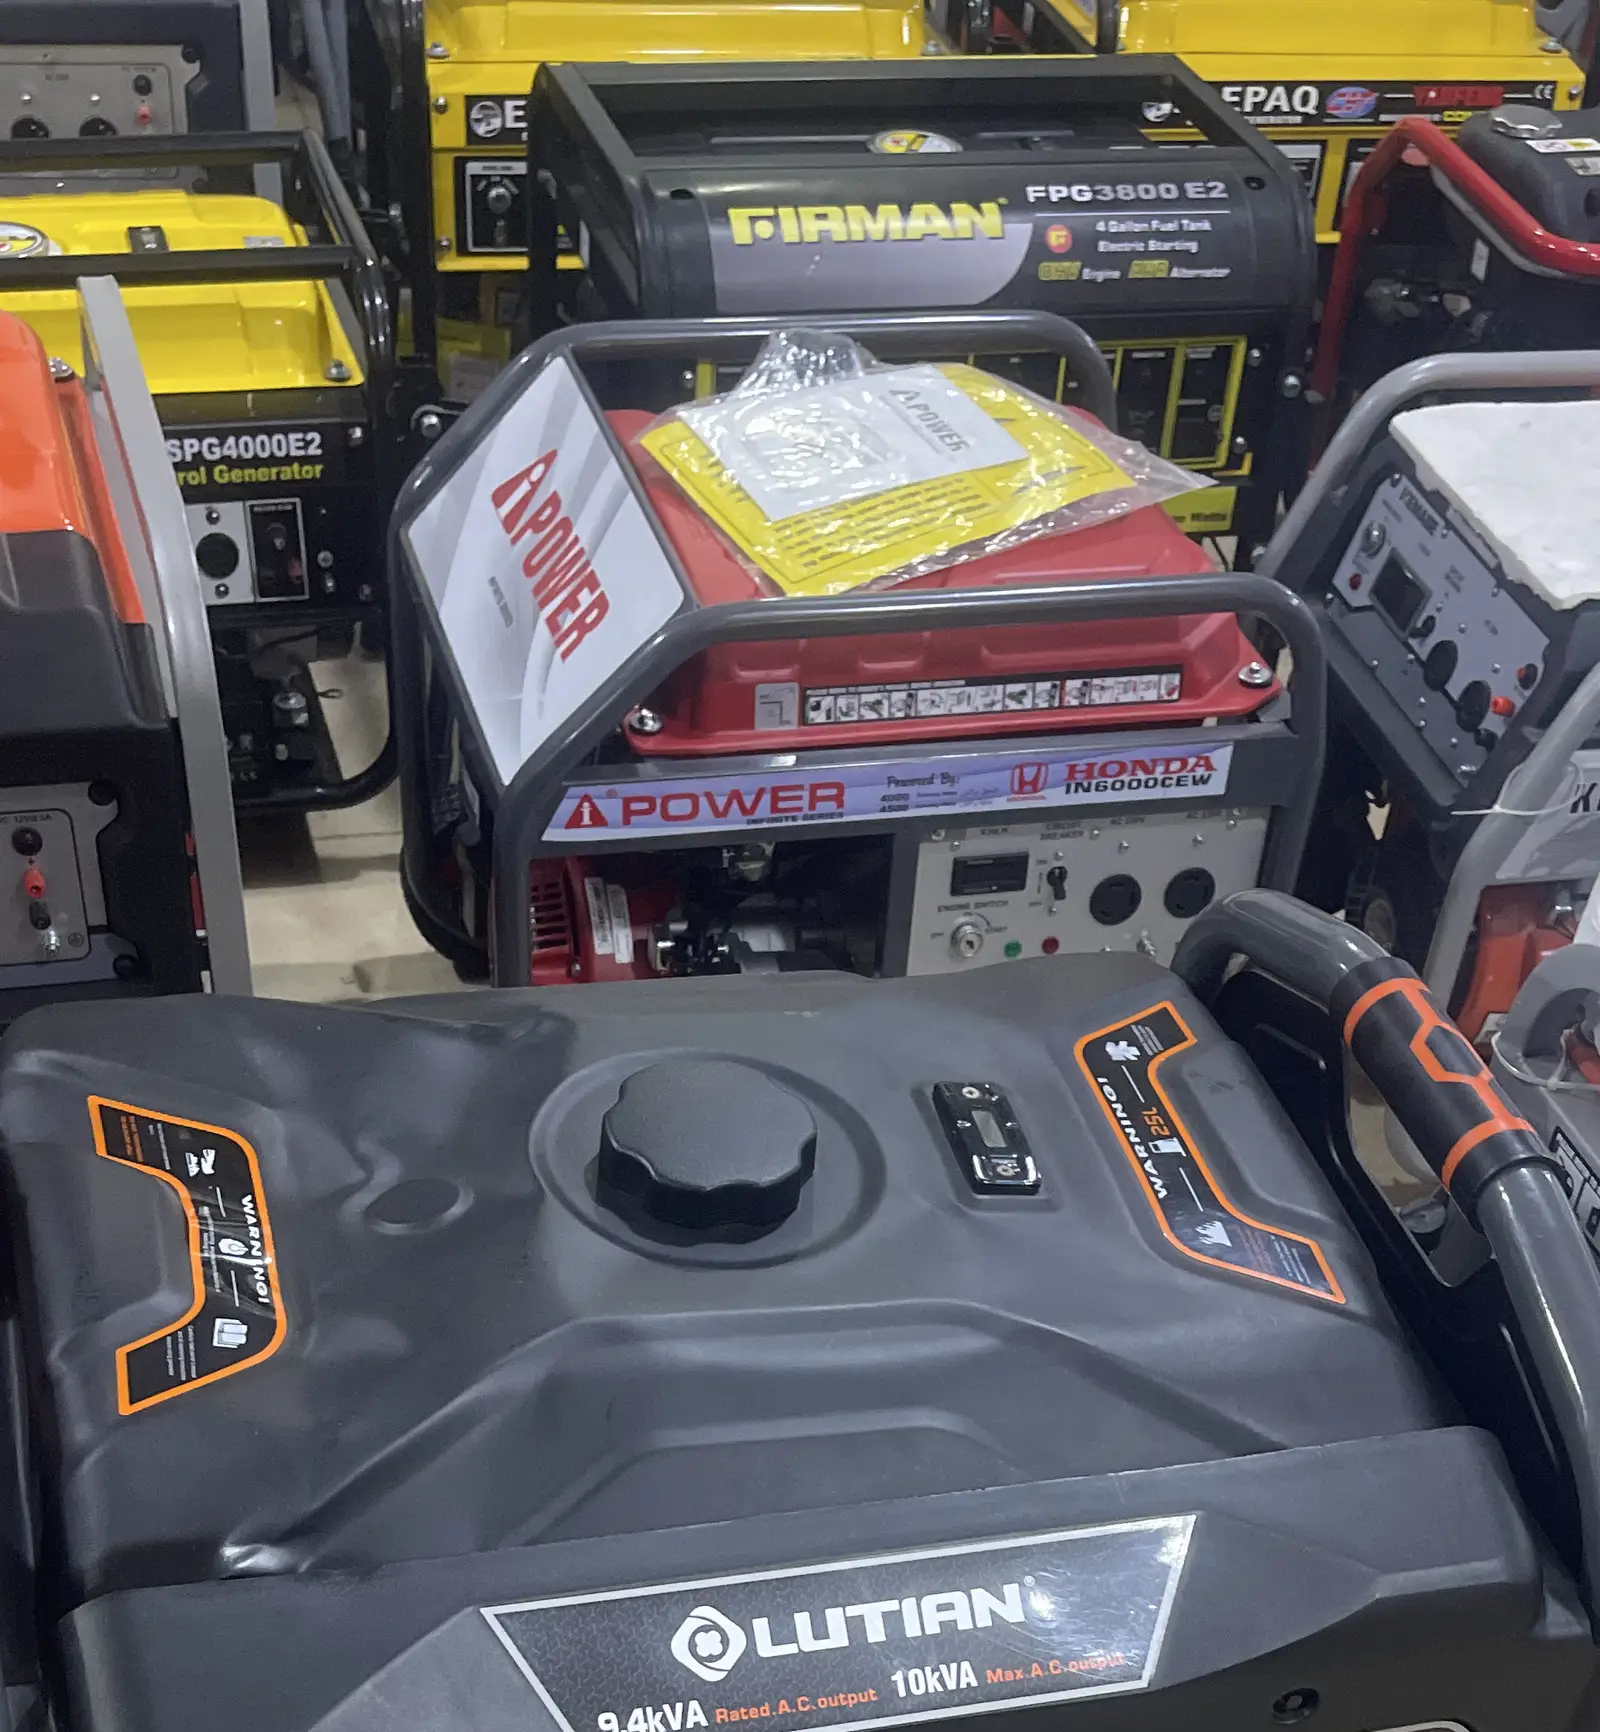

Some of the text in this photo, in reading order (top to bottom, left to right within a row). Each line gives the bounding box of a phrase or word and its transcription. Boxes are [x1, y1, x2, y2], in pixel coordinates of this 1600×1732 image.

[1025, 181, 1229, 202] FPG3800 E2
[727, 202, 1004, 245] FIRMAN
[165, 431, 323, 463] SPG4000E2
[213, 461, 324, 485] Generator
[1064, 755, 1217, 782] HONDA
[1065, 773, 1212, 795] IN6000CEW
[751, 1583, 1025, 1657] LUTIAN
[890, 1660, 978, 1698] 10kVA
